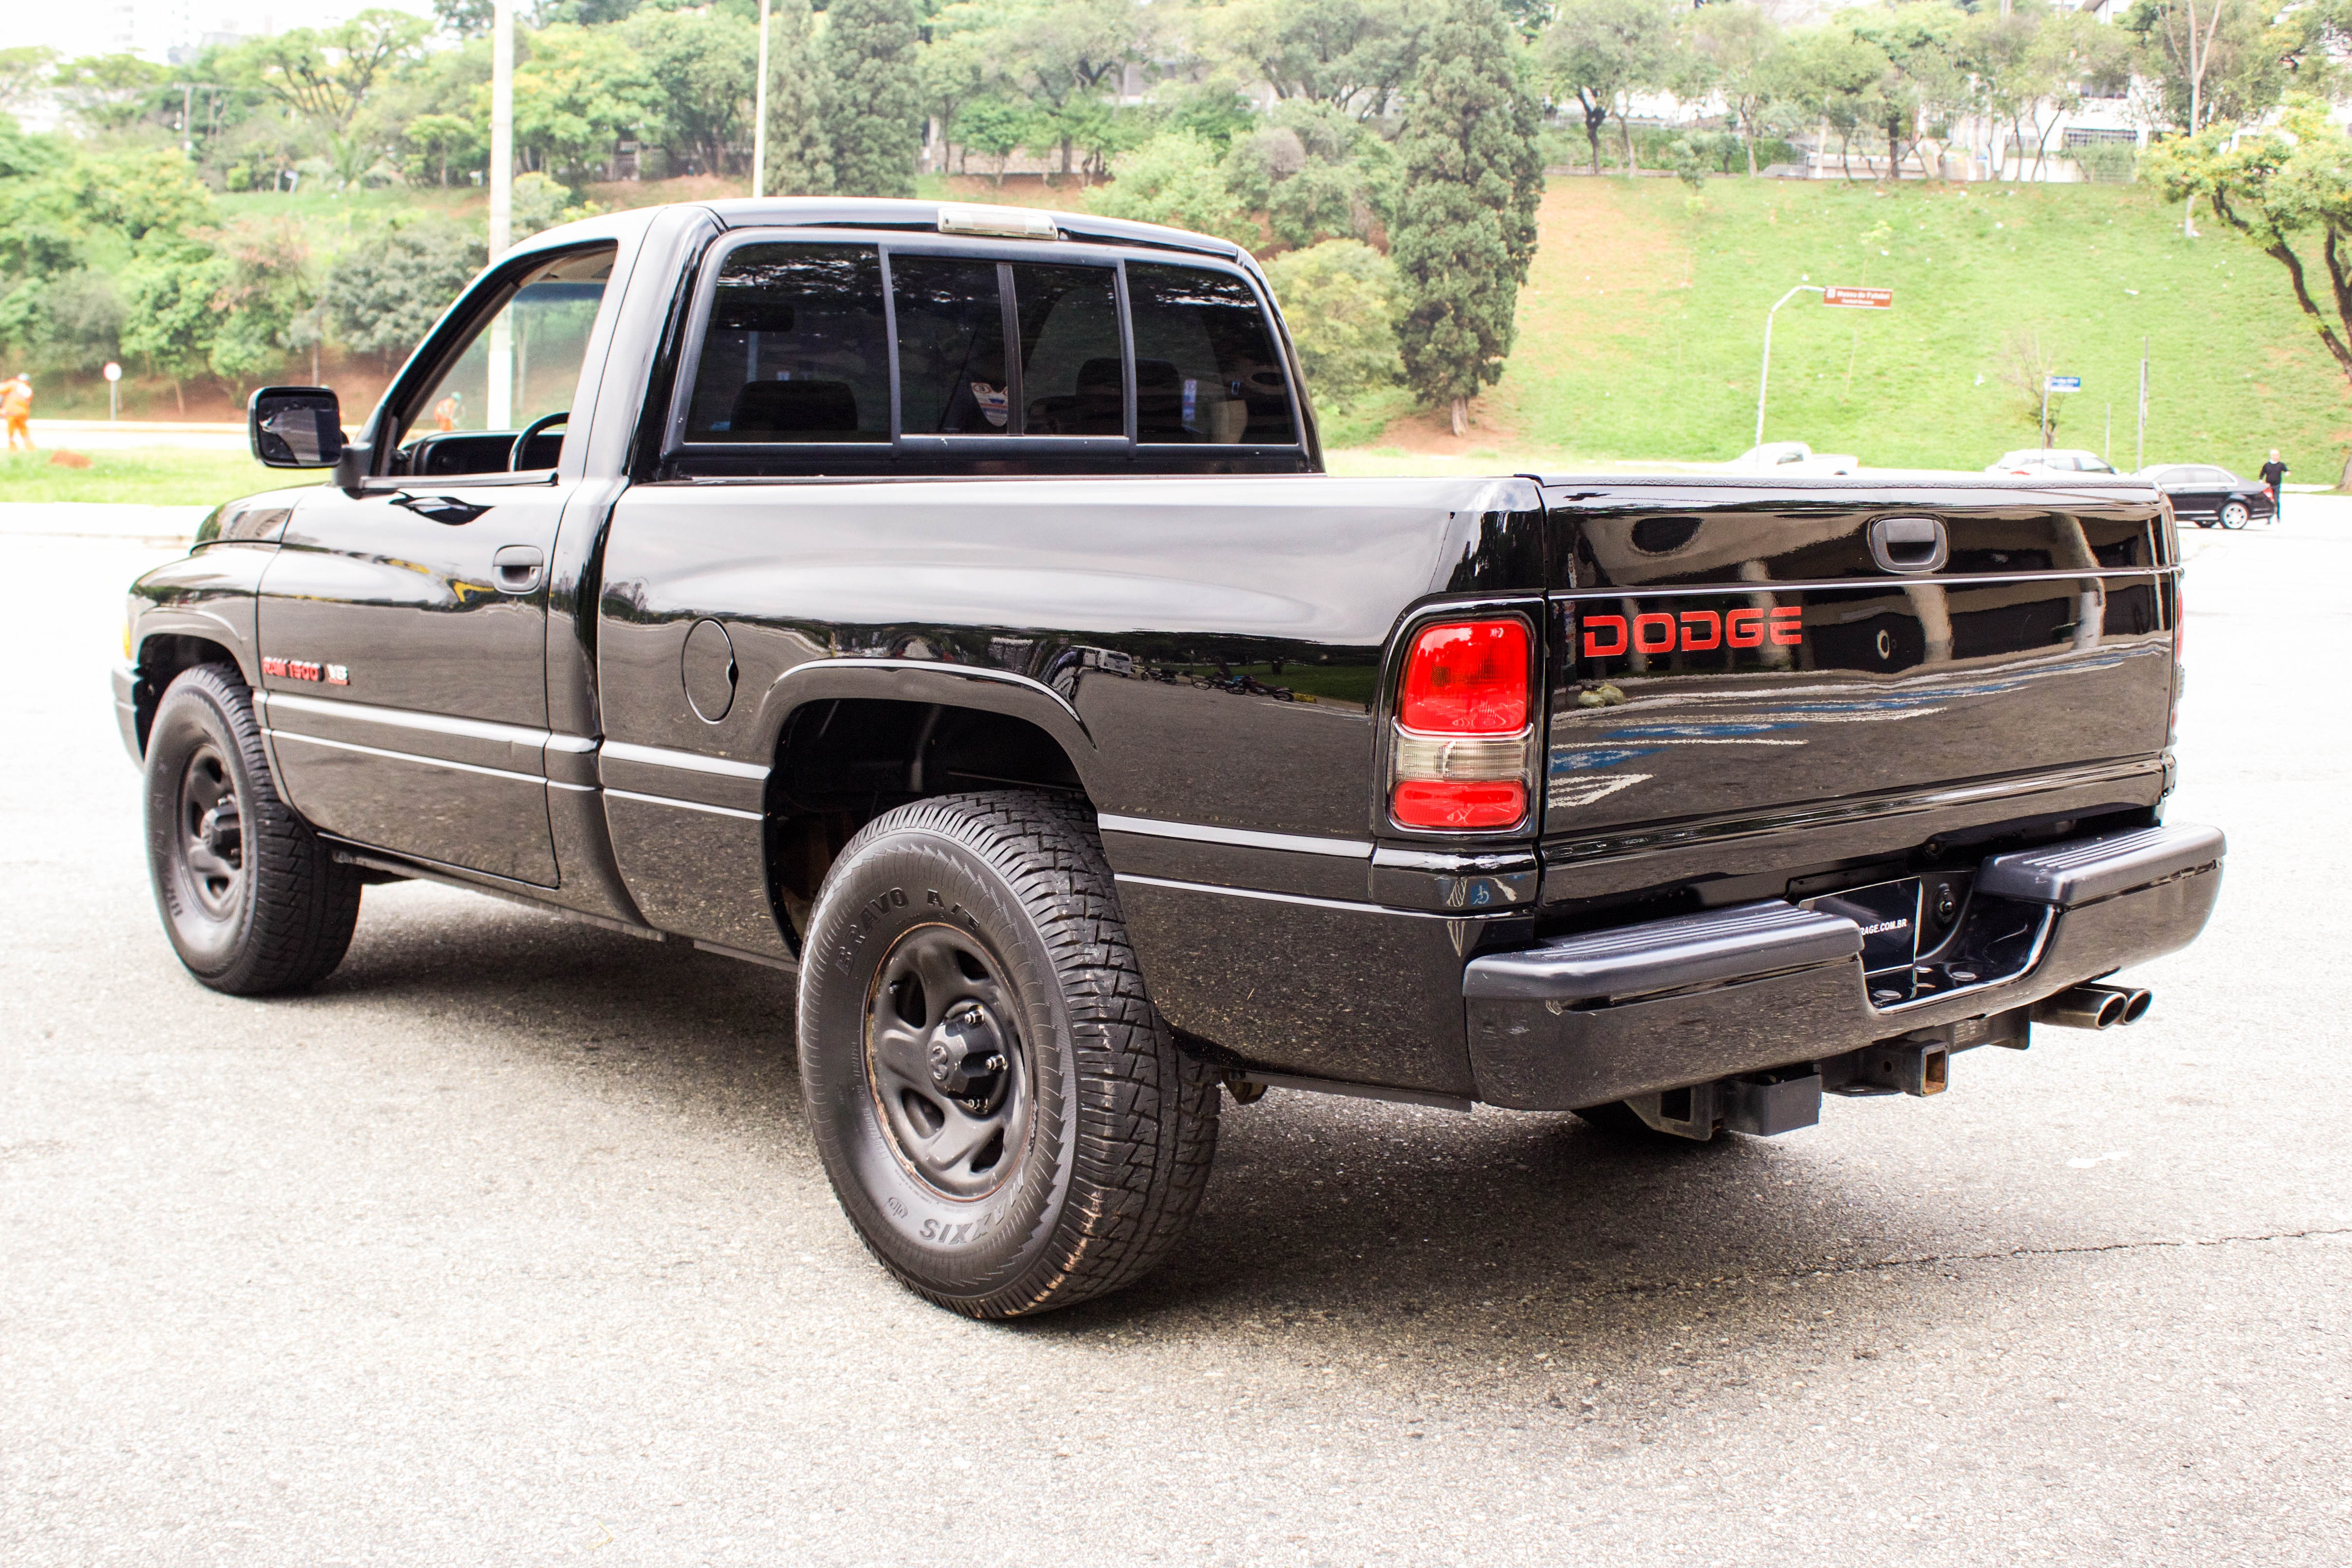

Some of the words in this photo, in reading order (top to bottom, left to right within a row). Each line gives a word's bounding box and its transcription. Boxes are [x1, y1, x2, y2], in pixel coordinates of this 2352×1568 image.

[1583, 606, 1802, 658] DODGE
[263, 657, 287, 677] RAM
[288, 660, 320, 681] 1500
[835, 887, 909, 976] BRAVO
[928, 888, 980, 931] A/T
[919, 1167, 1024, 1245] MAXXIS
